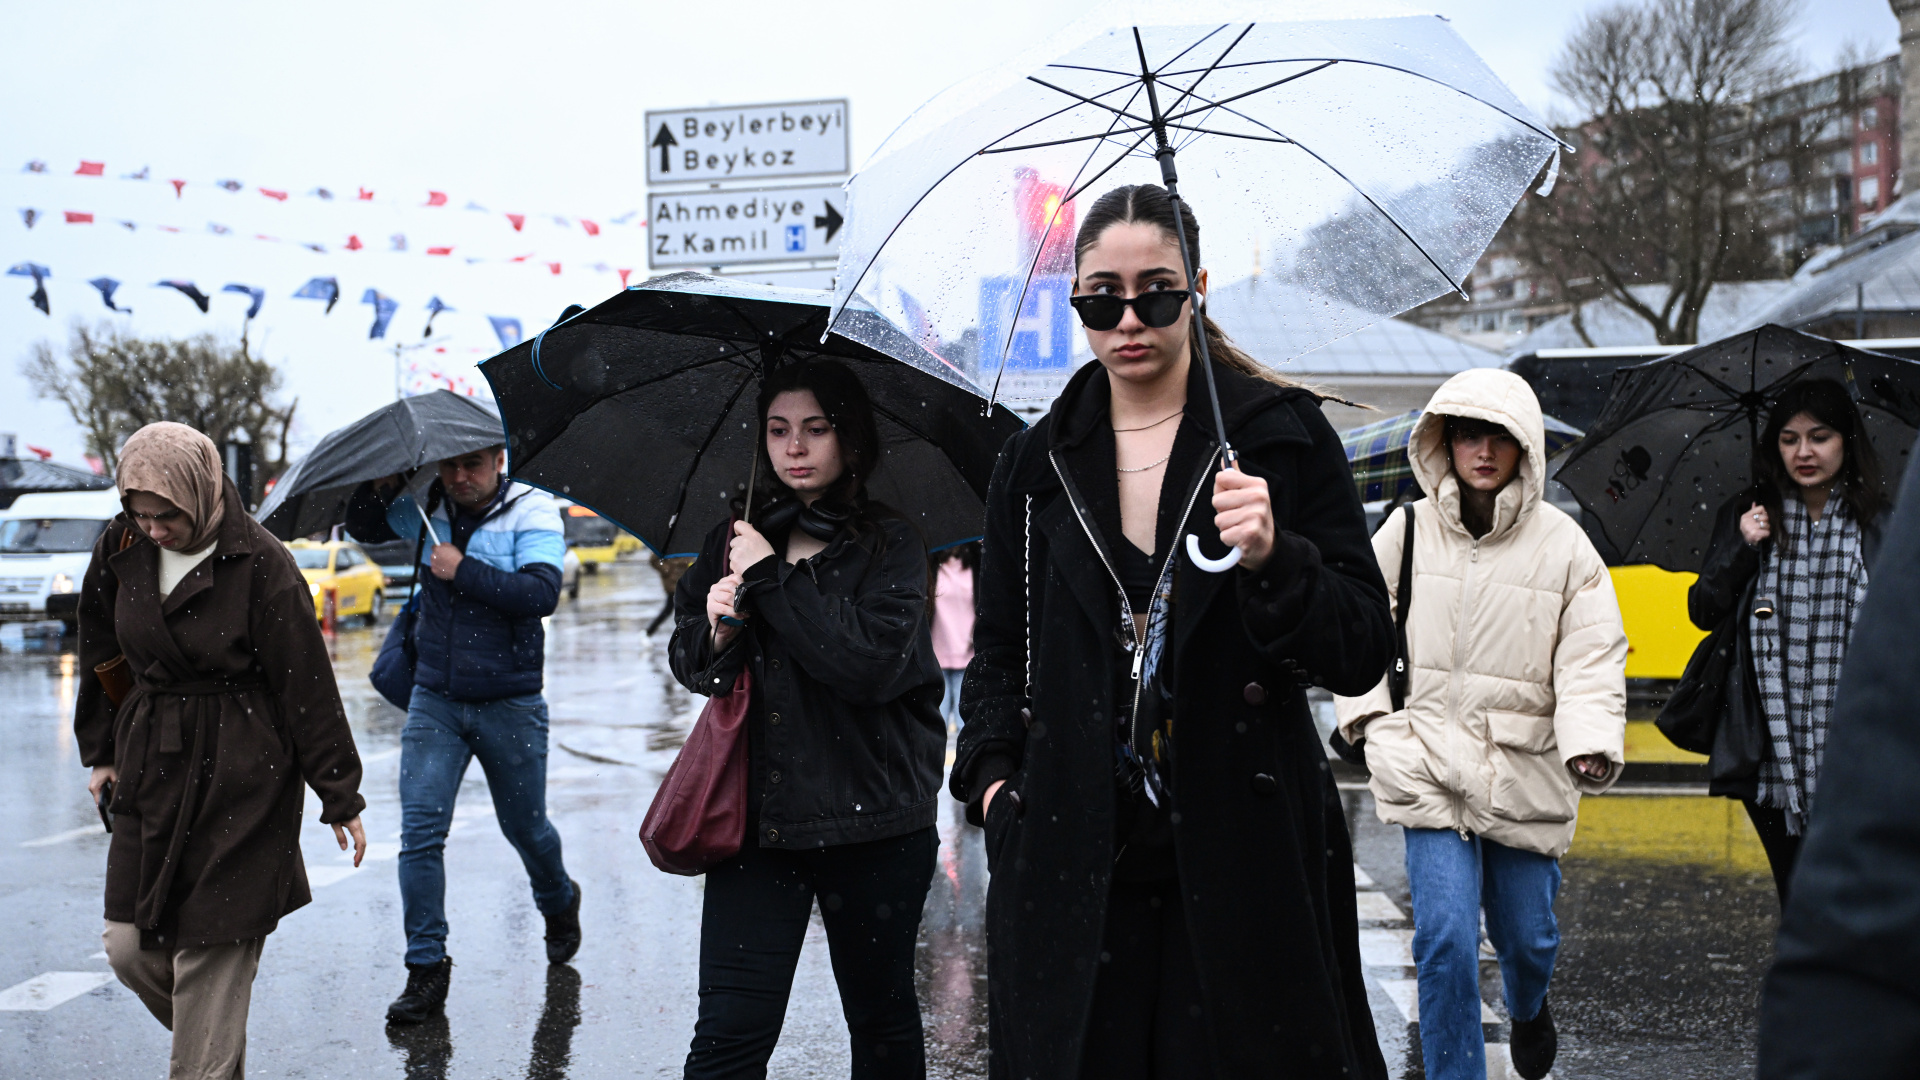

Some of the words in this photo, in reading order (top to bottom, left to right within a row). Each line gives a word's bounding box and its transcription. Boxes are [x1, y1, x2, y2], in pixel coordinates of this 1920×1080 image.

[684, 109, 841, 141] Beylerbeyi
[684, 147, 795, 174] Beykoz
[656, 198, 804, 223] Ahmediye
[787, 228, 804, 249] H
[999, 289, 1053, 358] H
